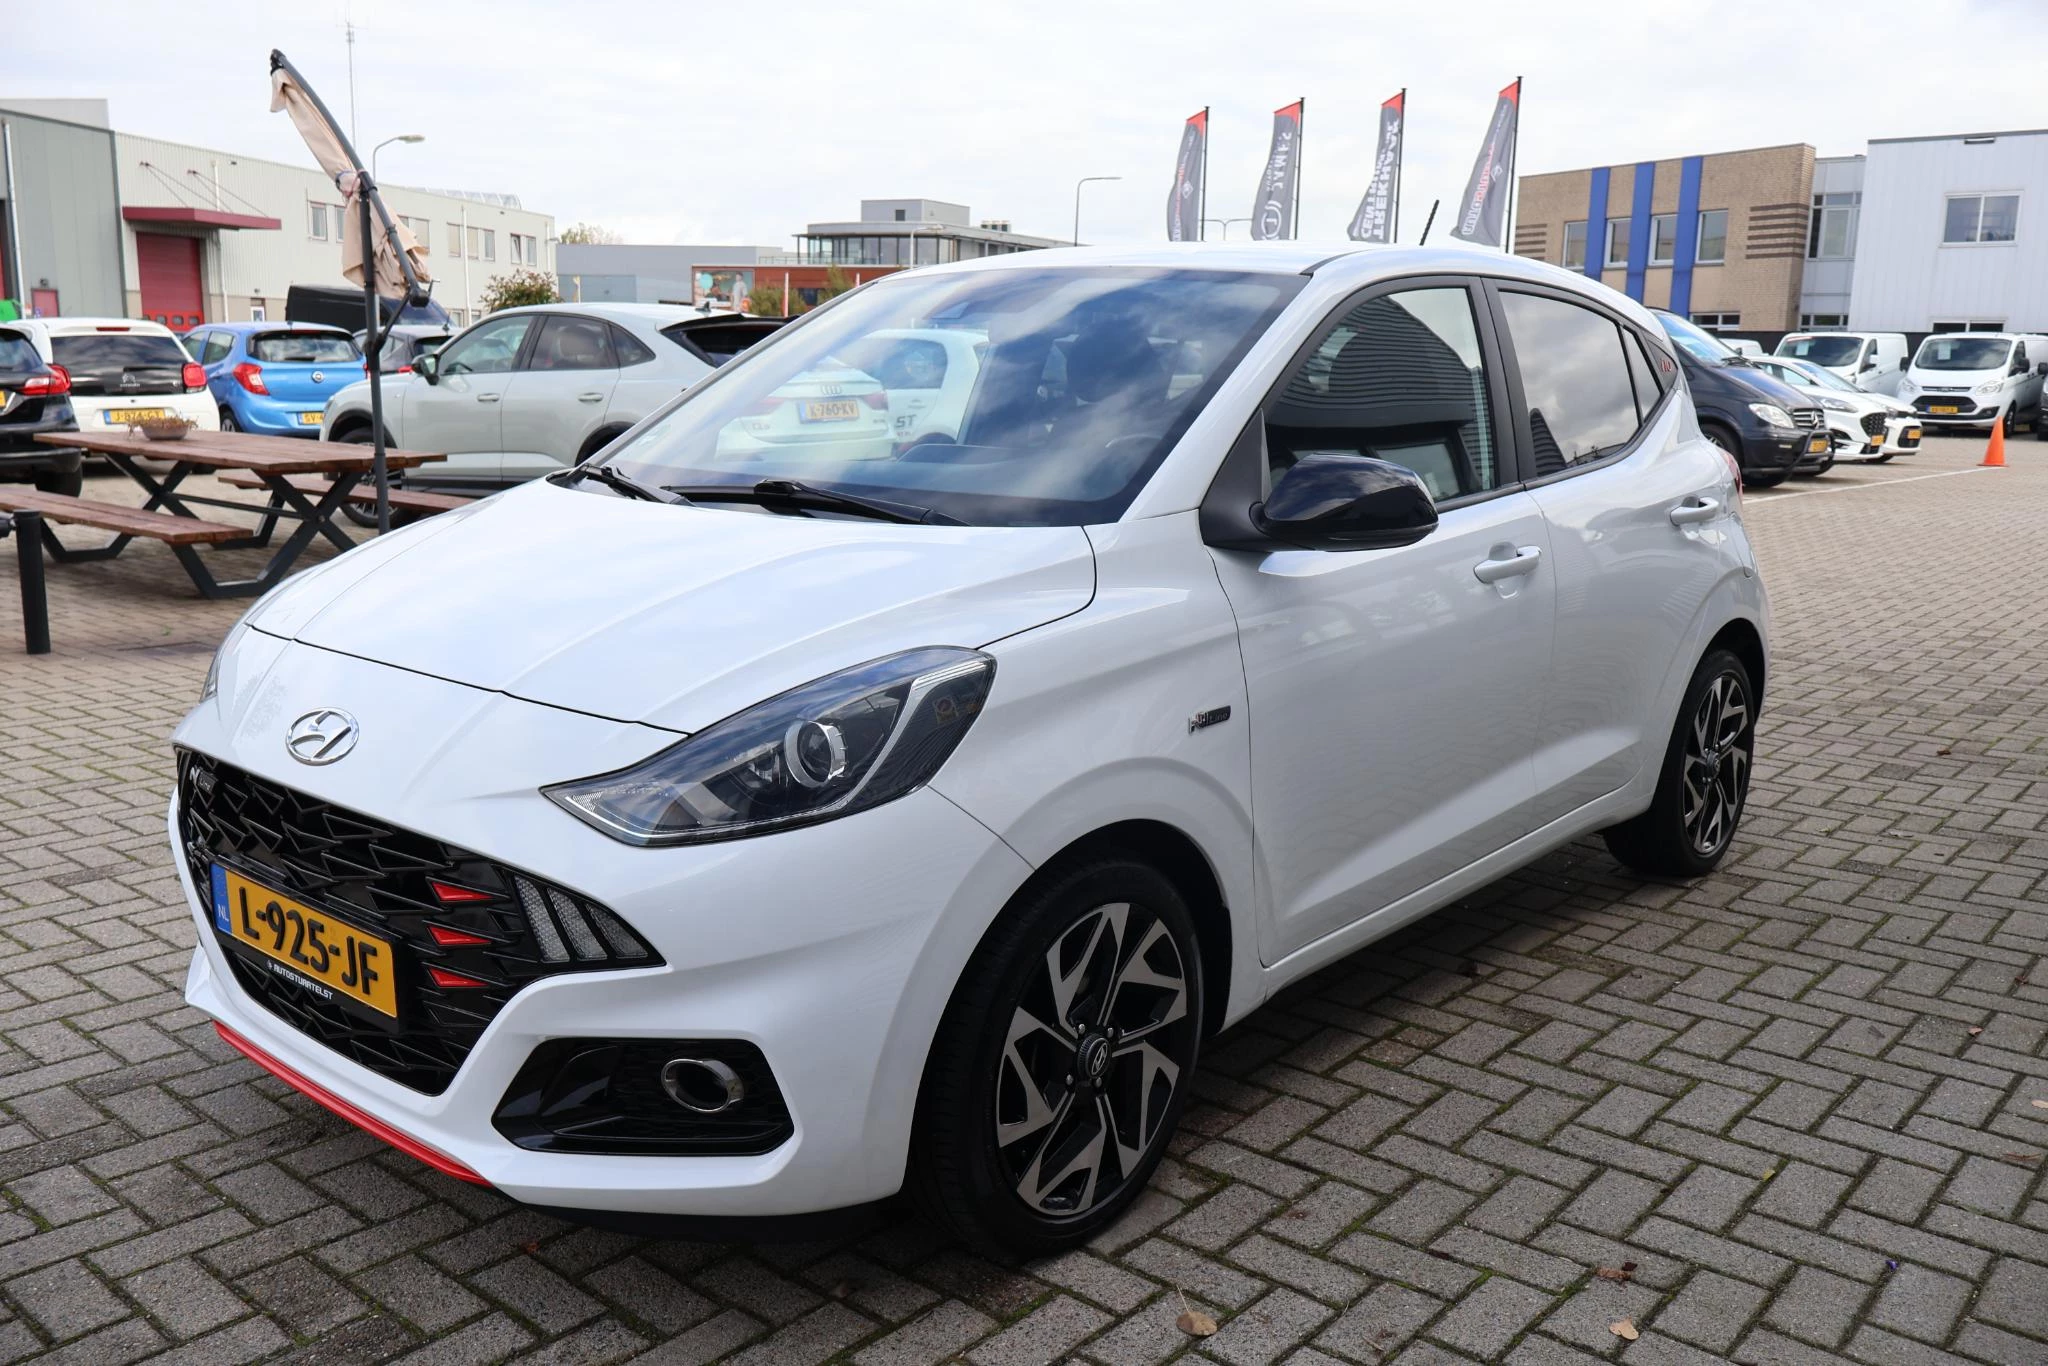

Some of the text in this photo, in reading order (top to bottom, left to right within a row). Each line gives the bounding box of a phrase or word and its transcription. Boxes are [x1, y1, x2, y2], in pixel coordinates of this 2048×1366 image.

[218, 904, 230, 923] NL
[238, 886, 379, 996] L-925-JF
[273, 964, 333, 1000] AUTOSTUARTELST
